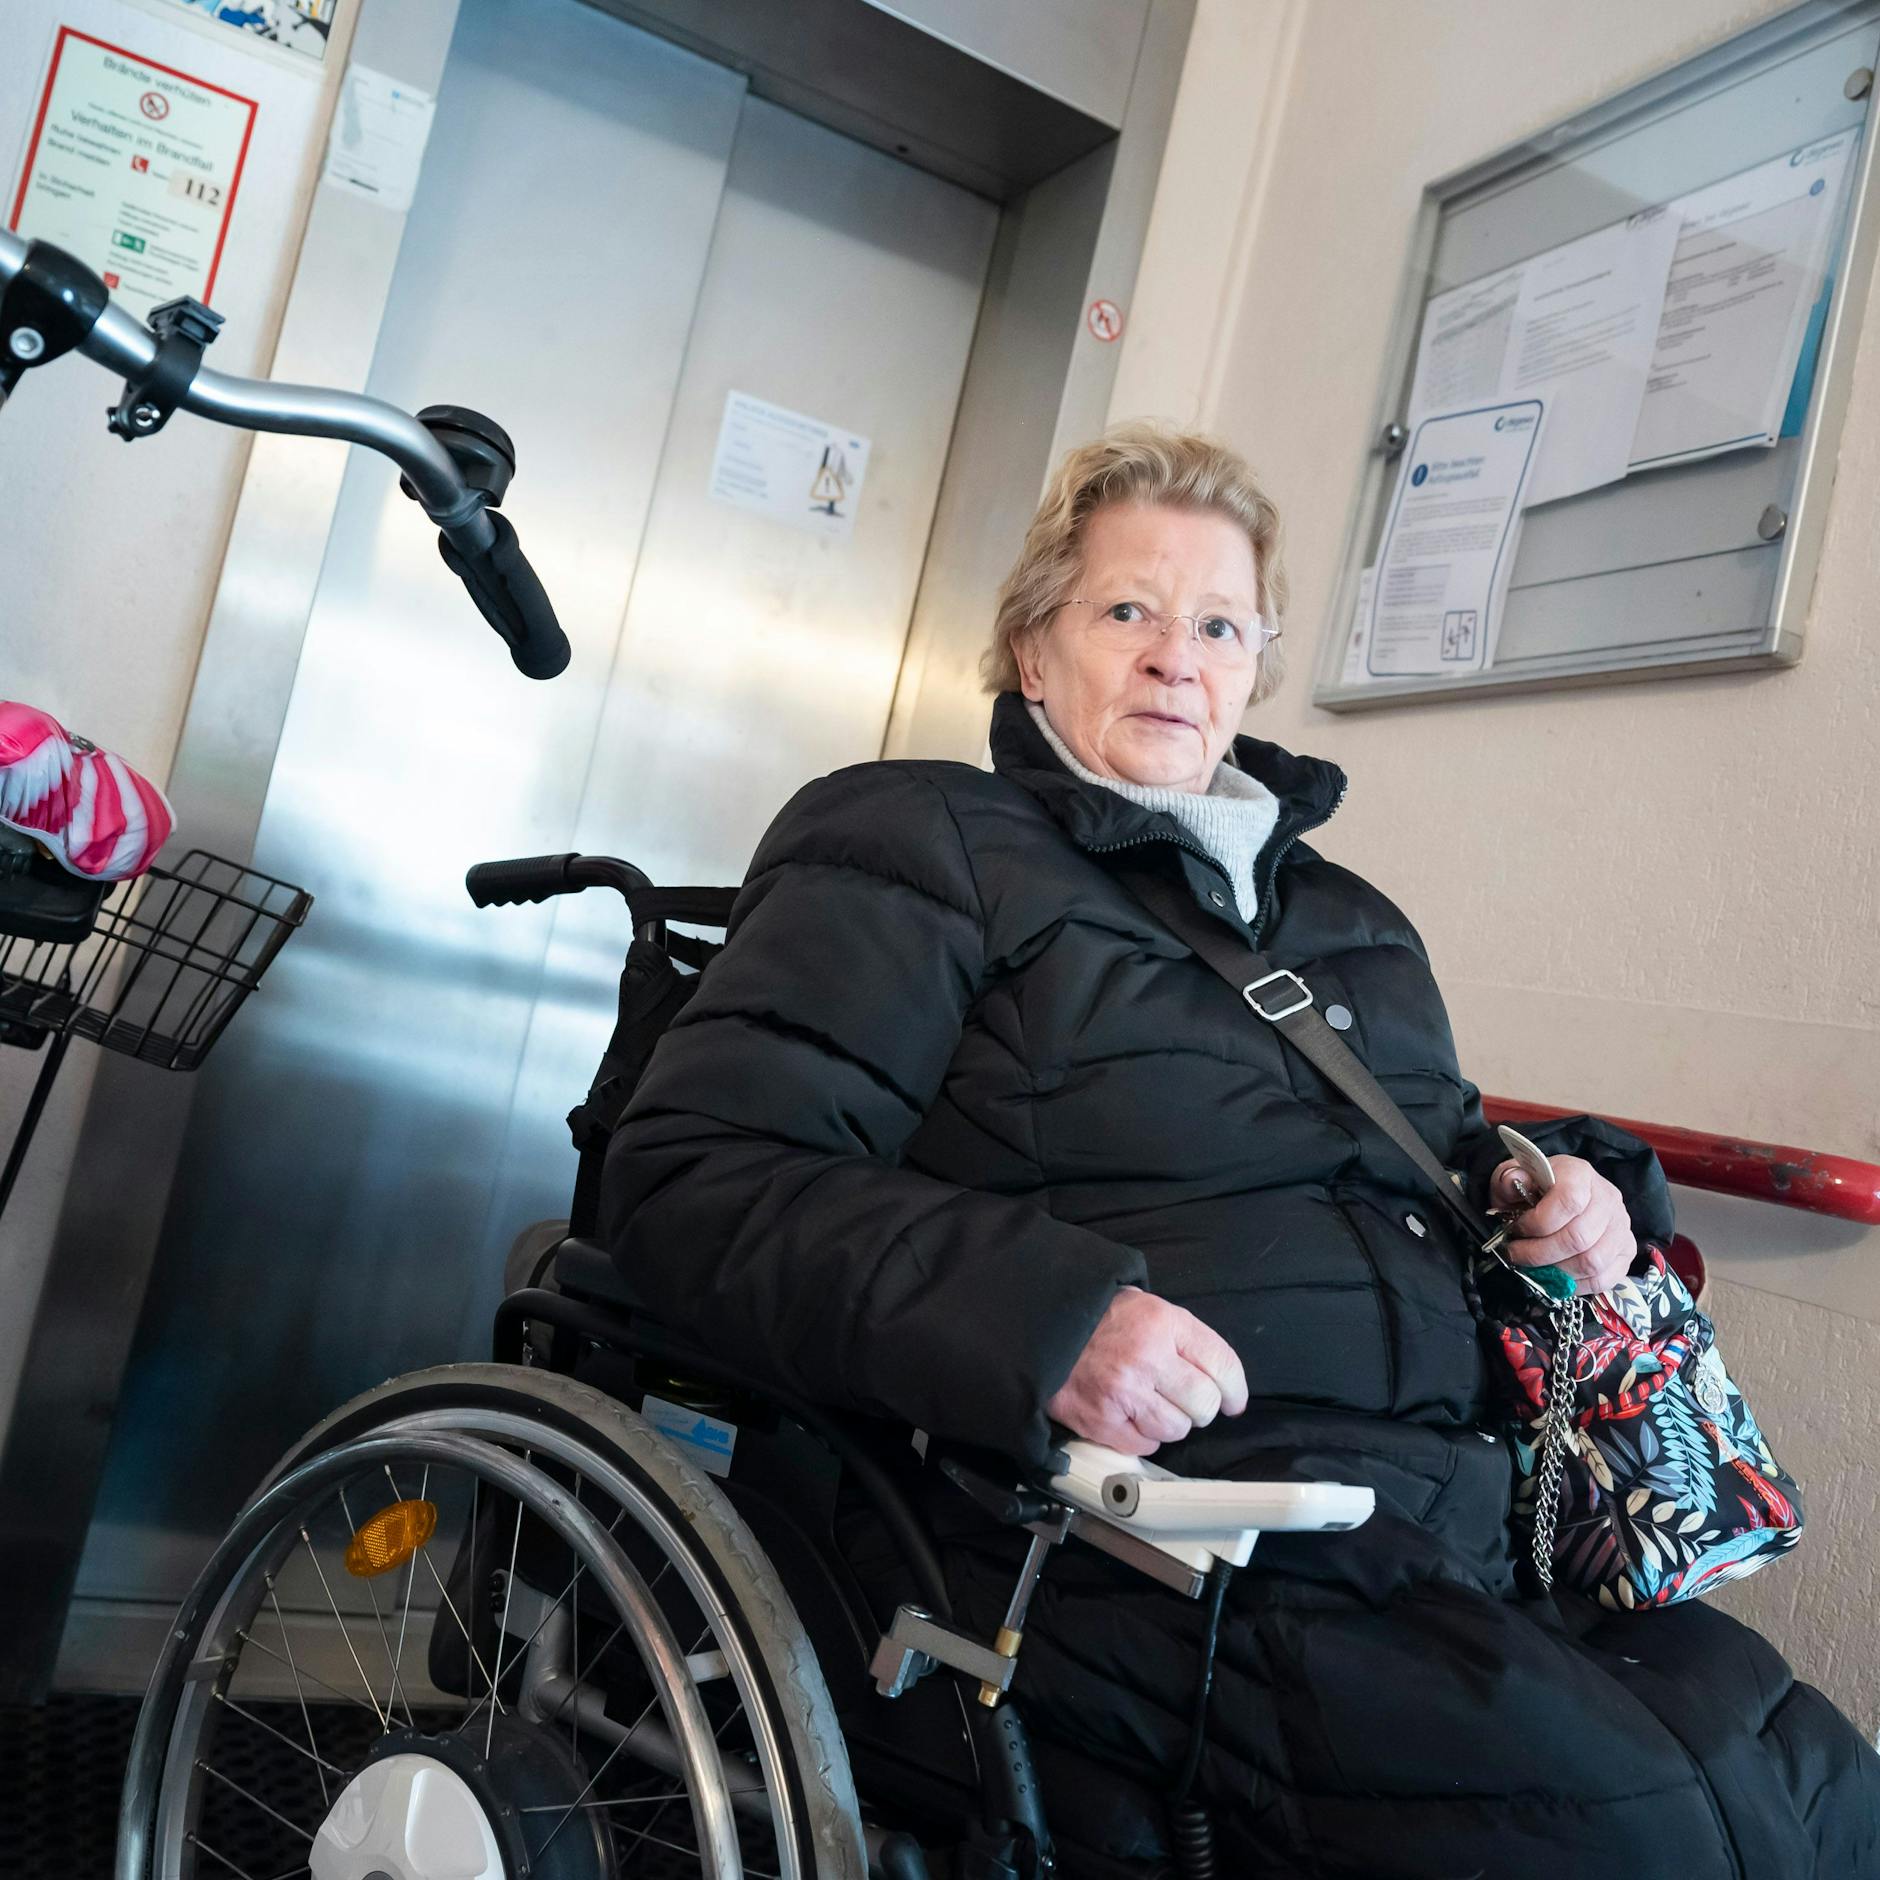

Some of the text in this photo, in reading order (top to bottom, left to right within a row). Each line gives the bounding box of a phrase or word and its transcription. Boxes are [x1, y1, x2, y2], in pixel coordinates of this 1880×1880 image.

[71, 109, 133, 144] Verhalten
[156, 142, 214, 172] Brandfall
[184, 177, 221, 207] 112
